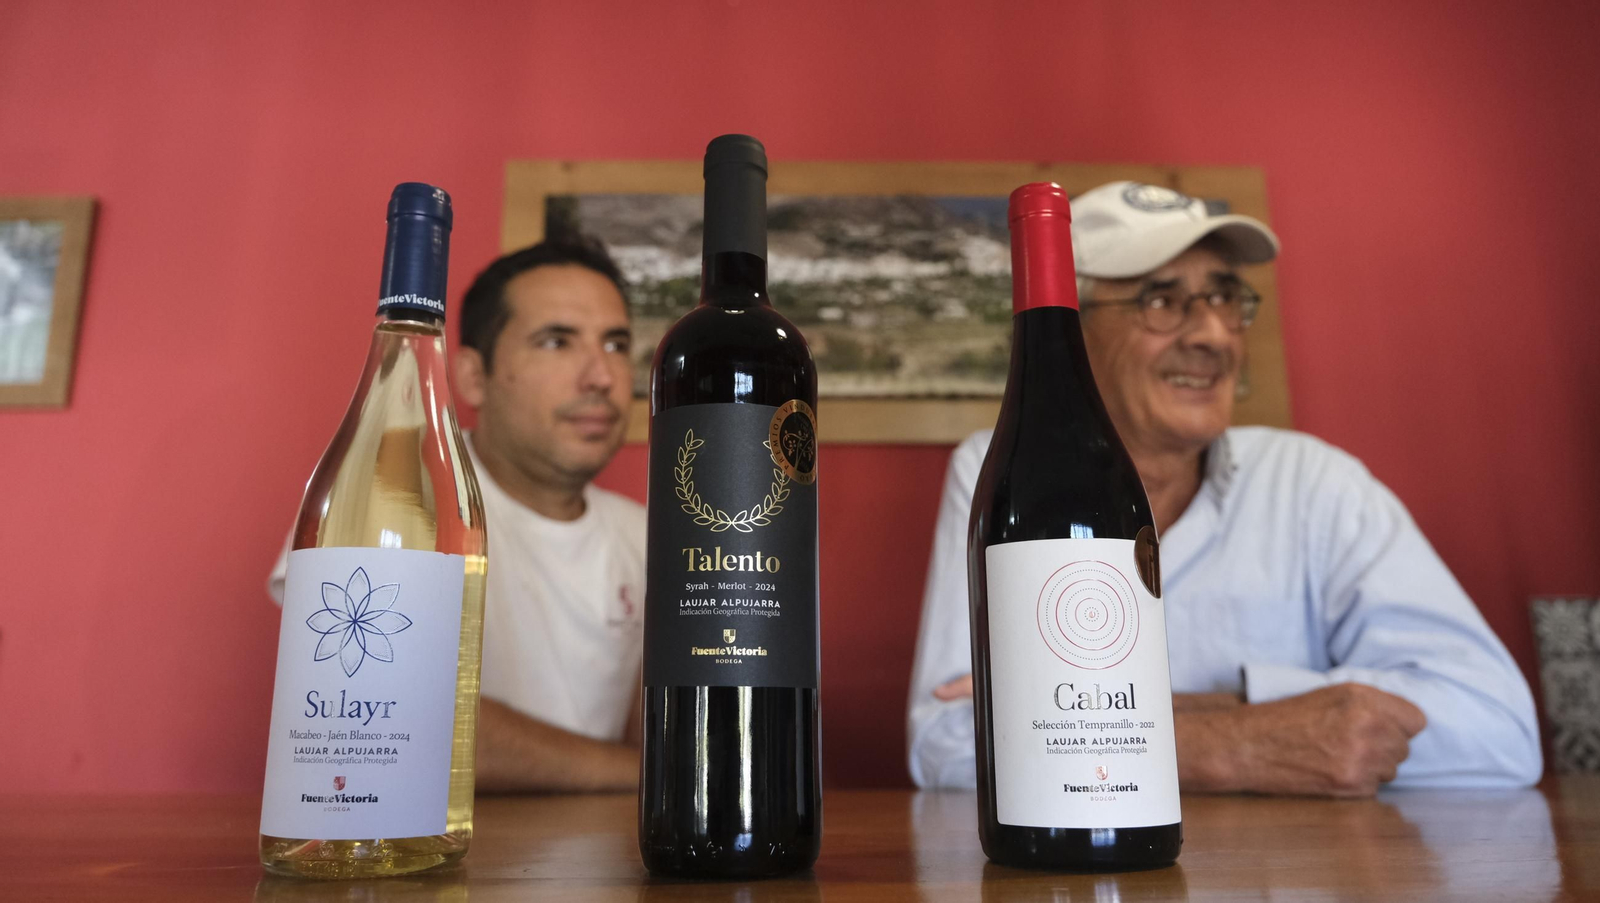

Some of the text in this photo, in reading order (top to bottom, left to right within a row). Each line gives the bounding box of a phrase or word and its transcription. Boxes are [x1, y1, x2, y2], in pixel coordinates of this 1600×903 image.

[378, 293, 445, 312] uenteVictoria
[682, 546, 781, 574] Talento
[685, 582, 709, 592] Syrah
[717, 582, 746, 590] Merlot
[755, 583, 776, 592] 2024
[680, 598, 781, 608] LAUJAR ALPUJARRA
[679, 607, 780, 618] Indicación Geográfica Protegida
[691, 646, 768, 656] FuenteVictoria
[1053, 682, 1137, 711] Cabal
[304, 689, 397, 726] Sulayr
[1032, 719, 1076, 730] Selección
[1077, 719, 1134, 732] Tempranillo
[1139, 721, 1155, 729] 2022
[289, 729, 322, 740] Macabeo
[327, 729, 347, 742] Jaén
[349, 730, 382, 740] Blanco
[389, 733, 410, 742] 2024
[1046, 737, 1147, 746] LAUJAR ALPUJARRA
[294, 746, 398, 755] LAUJAR ALPUJARRA
[1046, 746, 1148, 756] Indicación Geográfica Protegida
[293, 756, 398, 766] Indicación Geográfica Protegida
[1063, 782, 1139, 793] FuenteVictoria
[301, 793, 379, 803] FuenteVictoria
